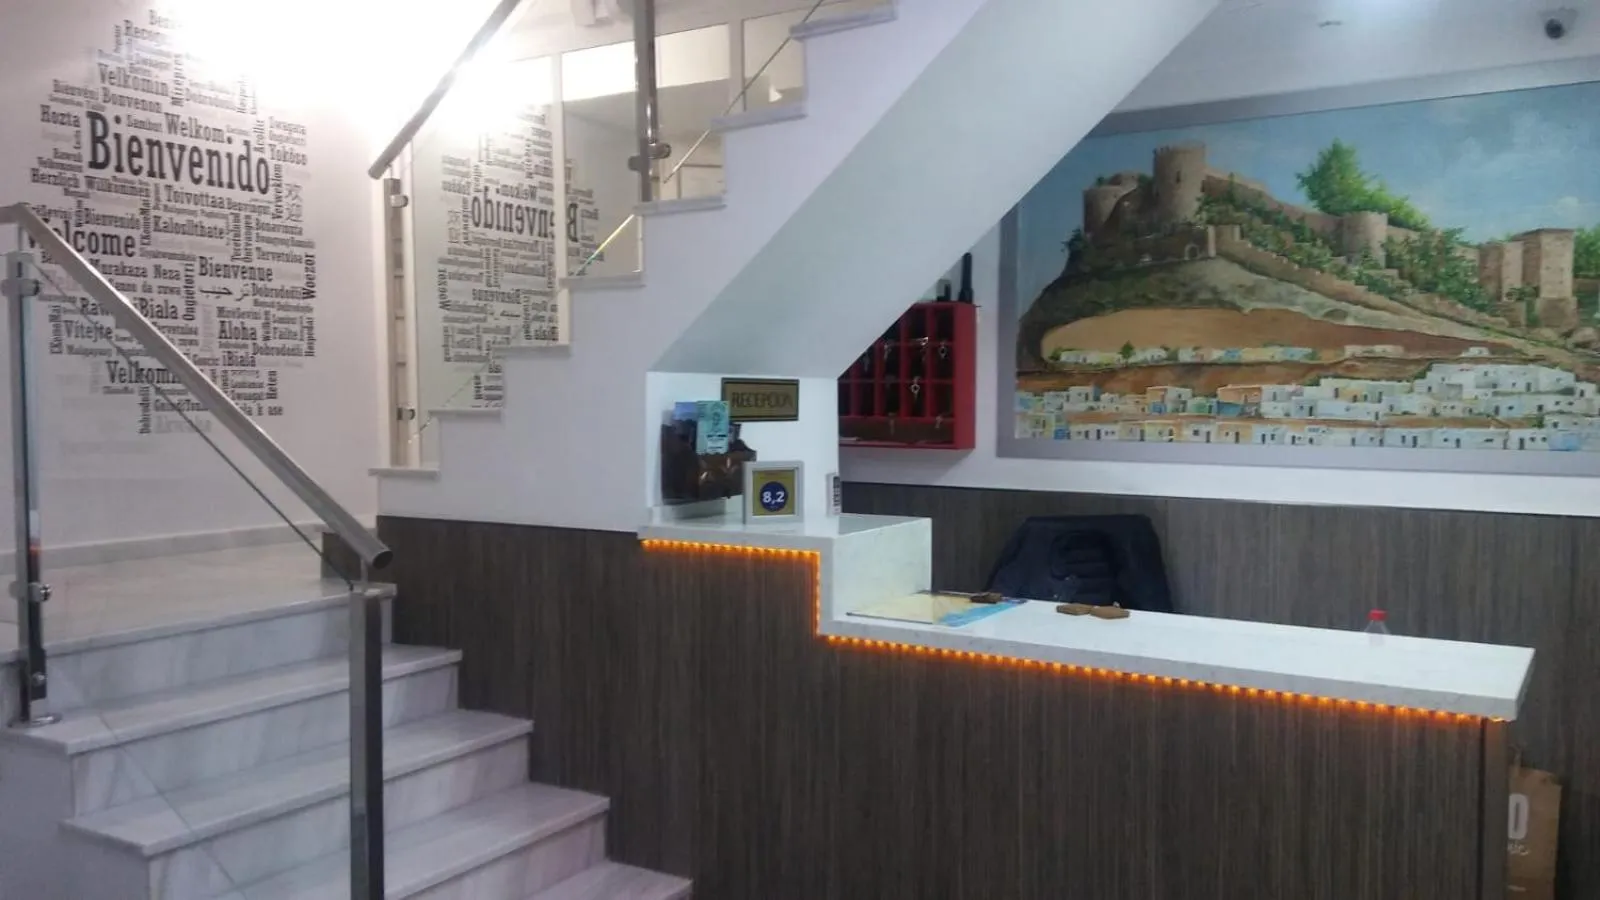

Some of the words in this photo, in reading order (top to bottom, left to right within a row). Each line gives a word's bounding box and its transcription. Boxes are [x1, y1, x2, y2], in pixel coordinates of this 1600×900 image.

[164, 112, 225, 144] Welkom
[85, 110, 269, 195] Bienvenido
[198, 255, 273, 282] Bienvenue
[218, 320, 257, 340] Aloha
[762, 490, 786, 505] 8,2
